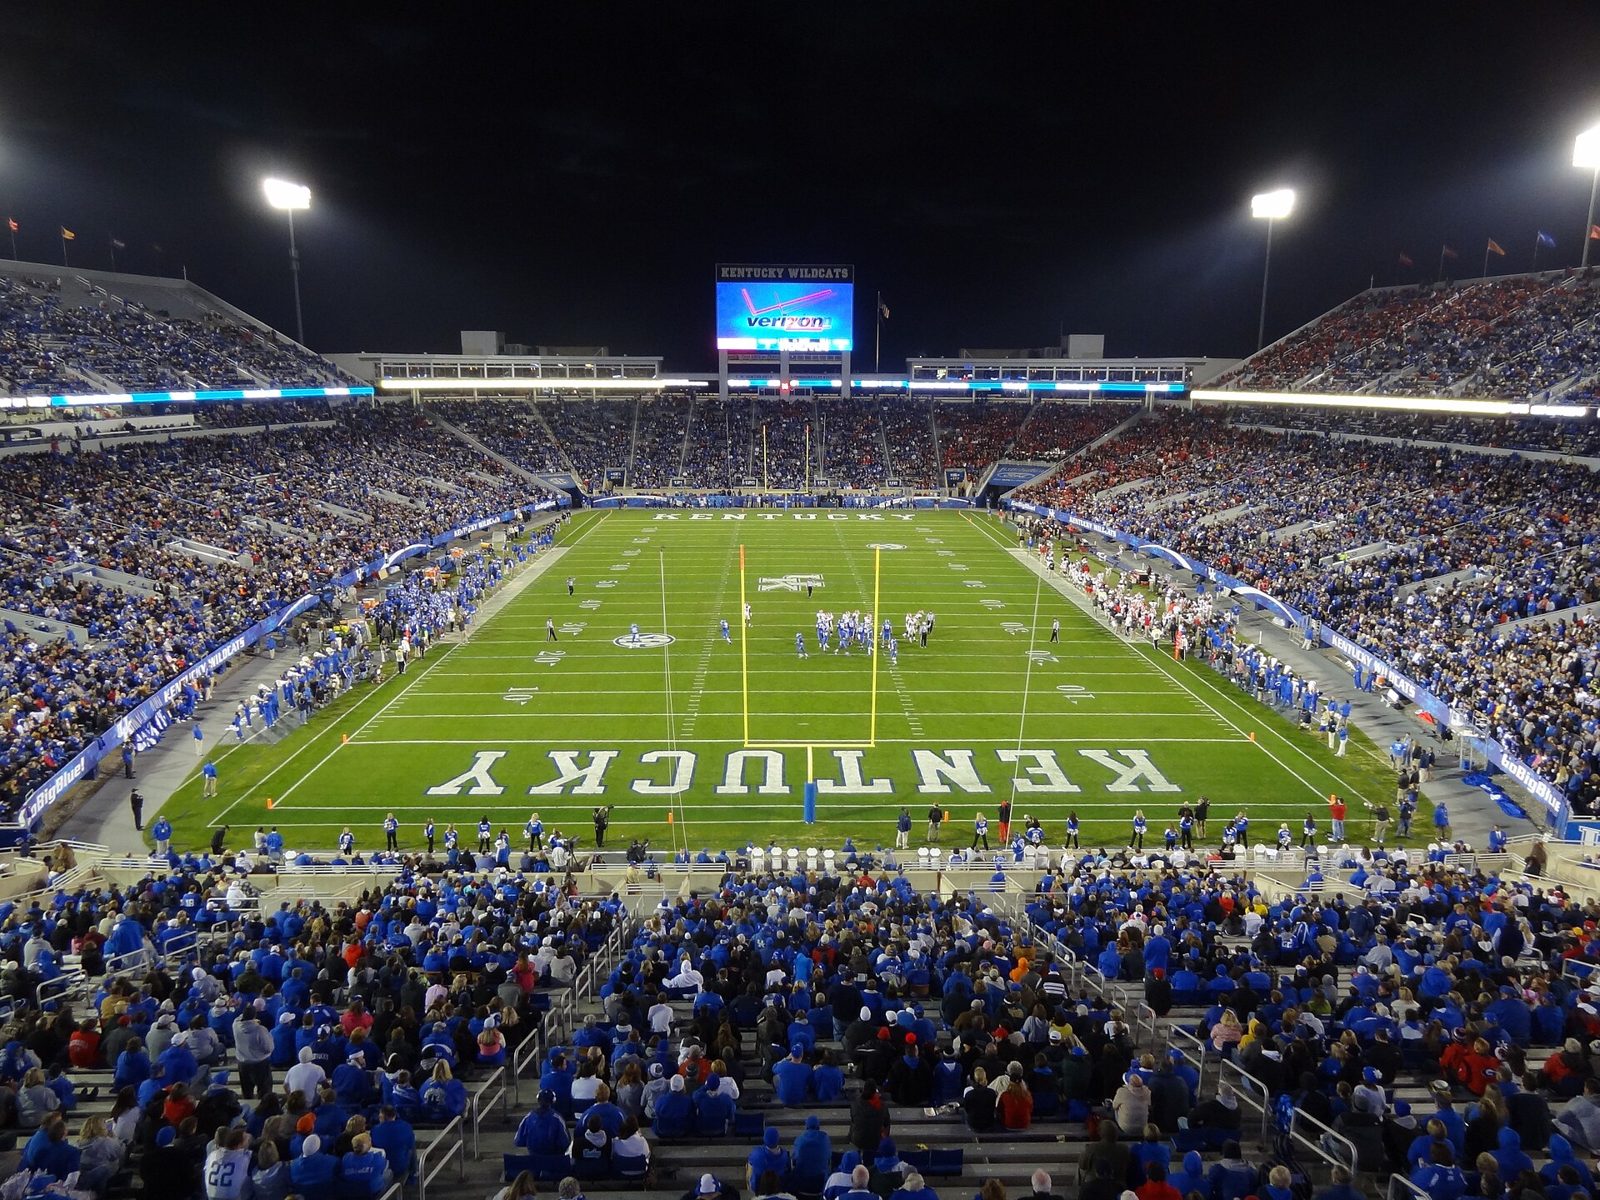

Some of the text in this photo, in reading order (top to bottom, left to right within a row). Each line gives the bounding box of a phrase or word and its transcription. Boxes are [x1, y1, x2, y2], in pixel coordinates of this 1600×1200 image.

[721, 267, 849, 279] KENTUCKY WILDCATS
[747, 314, 829, 330] verizon
[558, 621, 588, 633] 30
[1000, 622, 1029, 633] 30
[534, 650, 567, 663] 20
[1025, 650, 1060, 663] 20
[1332, 634, 1416, 698] KENTUCKY WILDCATS
[503, 686, 540, 701] 10
[1056, 685, 1096, 699] 10
[425, 749, 1183, 796] KENTUCKY
[208, 1160, 236, 1187] 22
